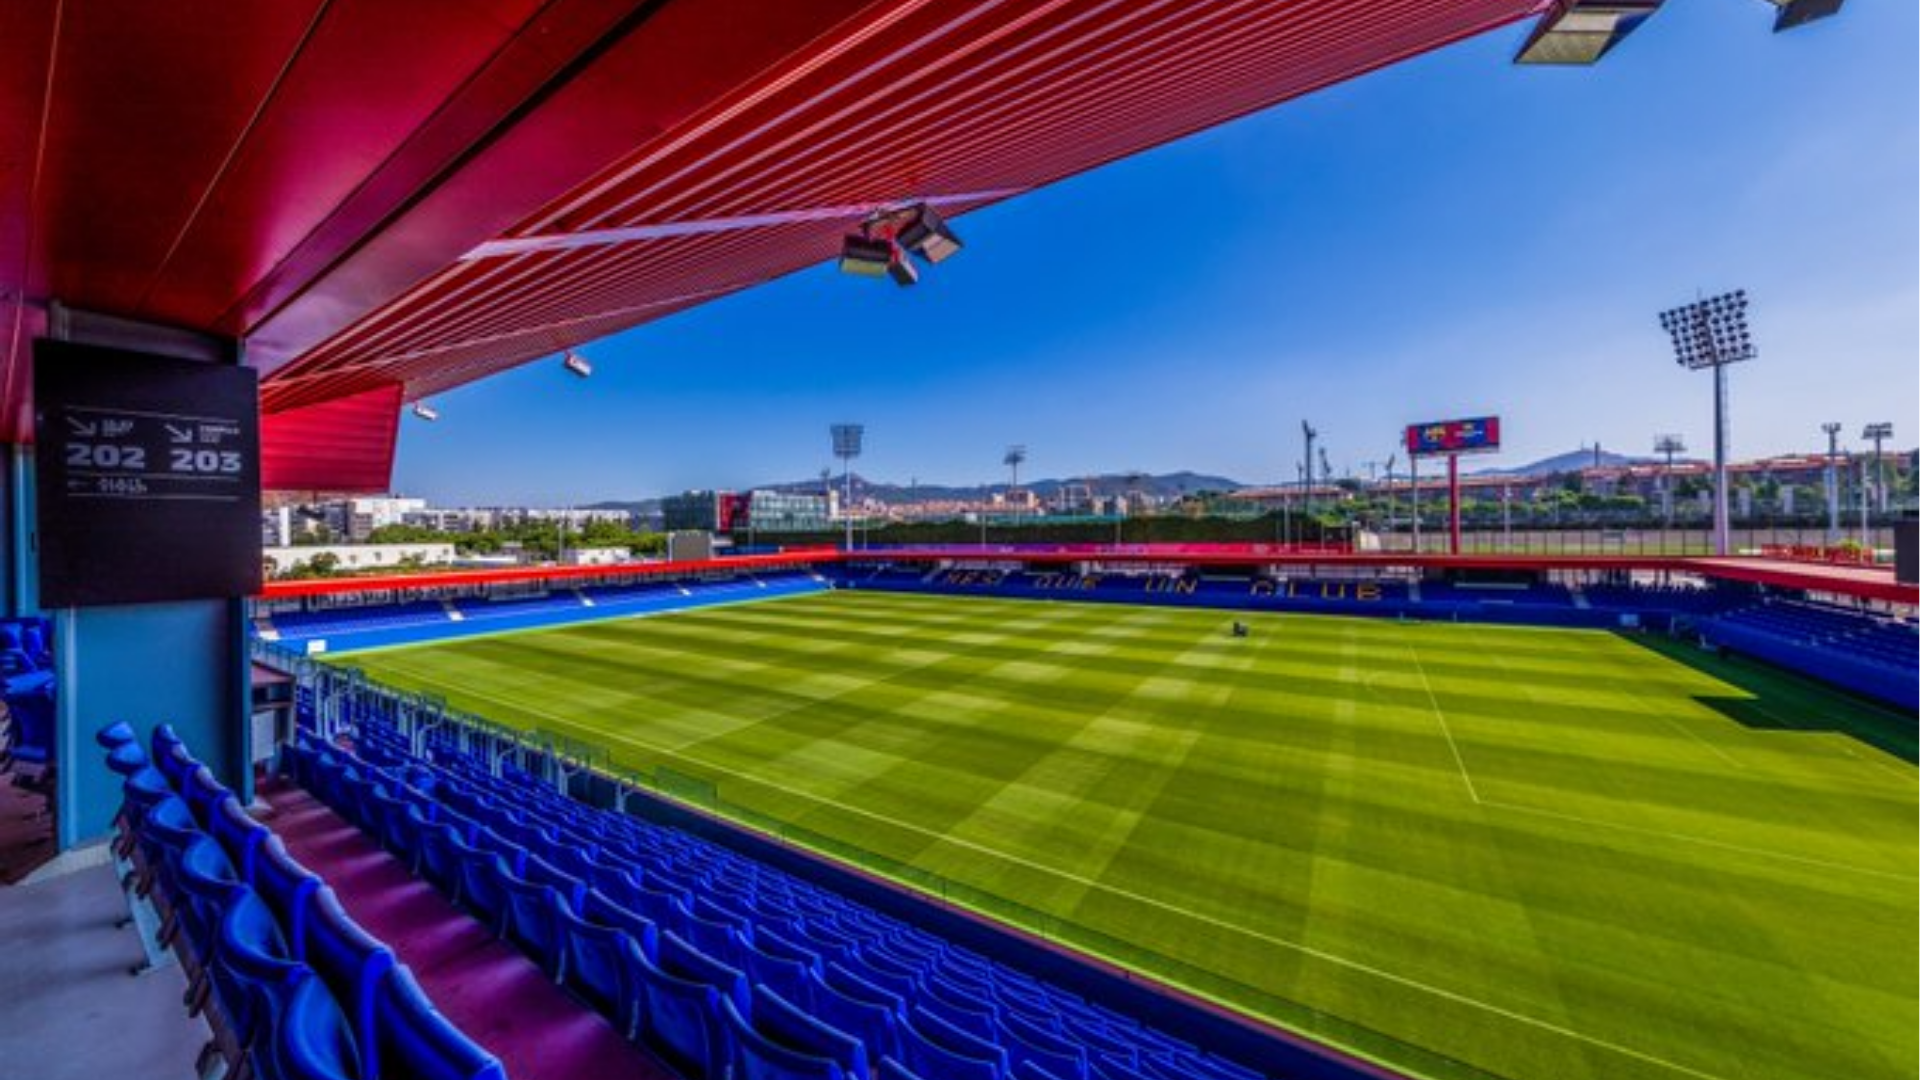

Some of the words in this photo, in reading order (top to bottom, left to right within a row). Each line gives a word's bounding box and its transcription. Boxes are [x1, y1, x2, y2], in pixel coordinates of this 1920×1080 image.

[66, 443, 146, 468] 202
[170, 449, 242, 472] 203
[1145, 579, 1197, 594] UN
[1250, 580, 1382, 600] CLUB
